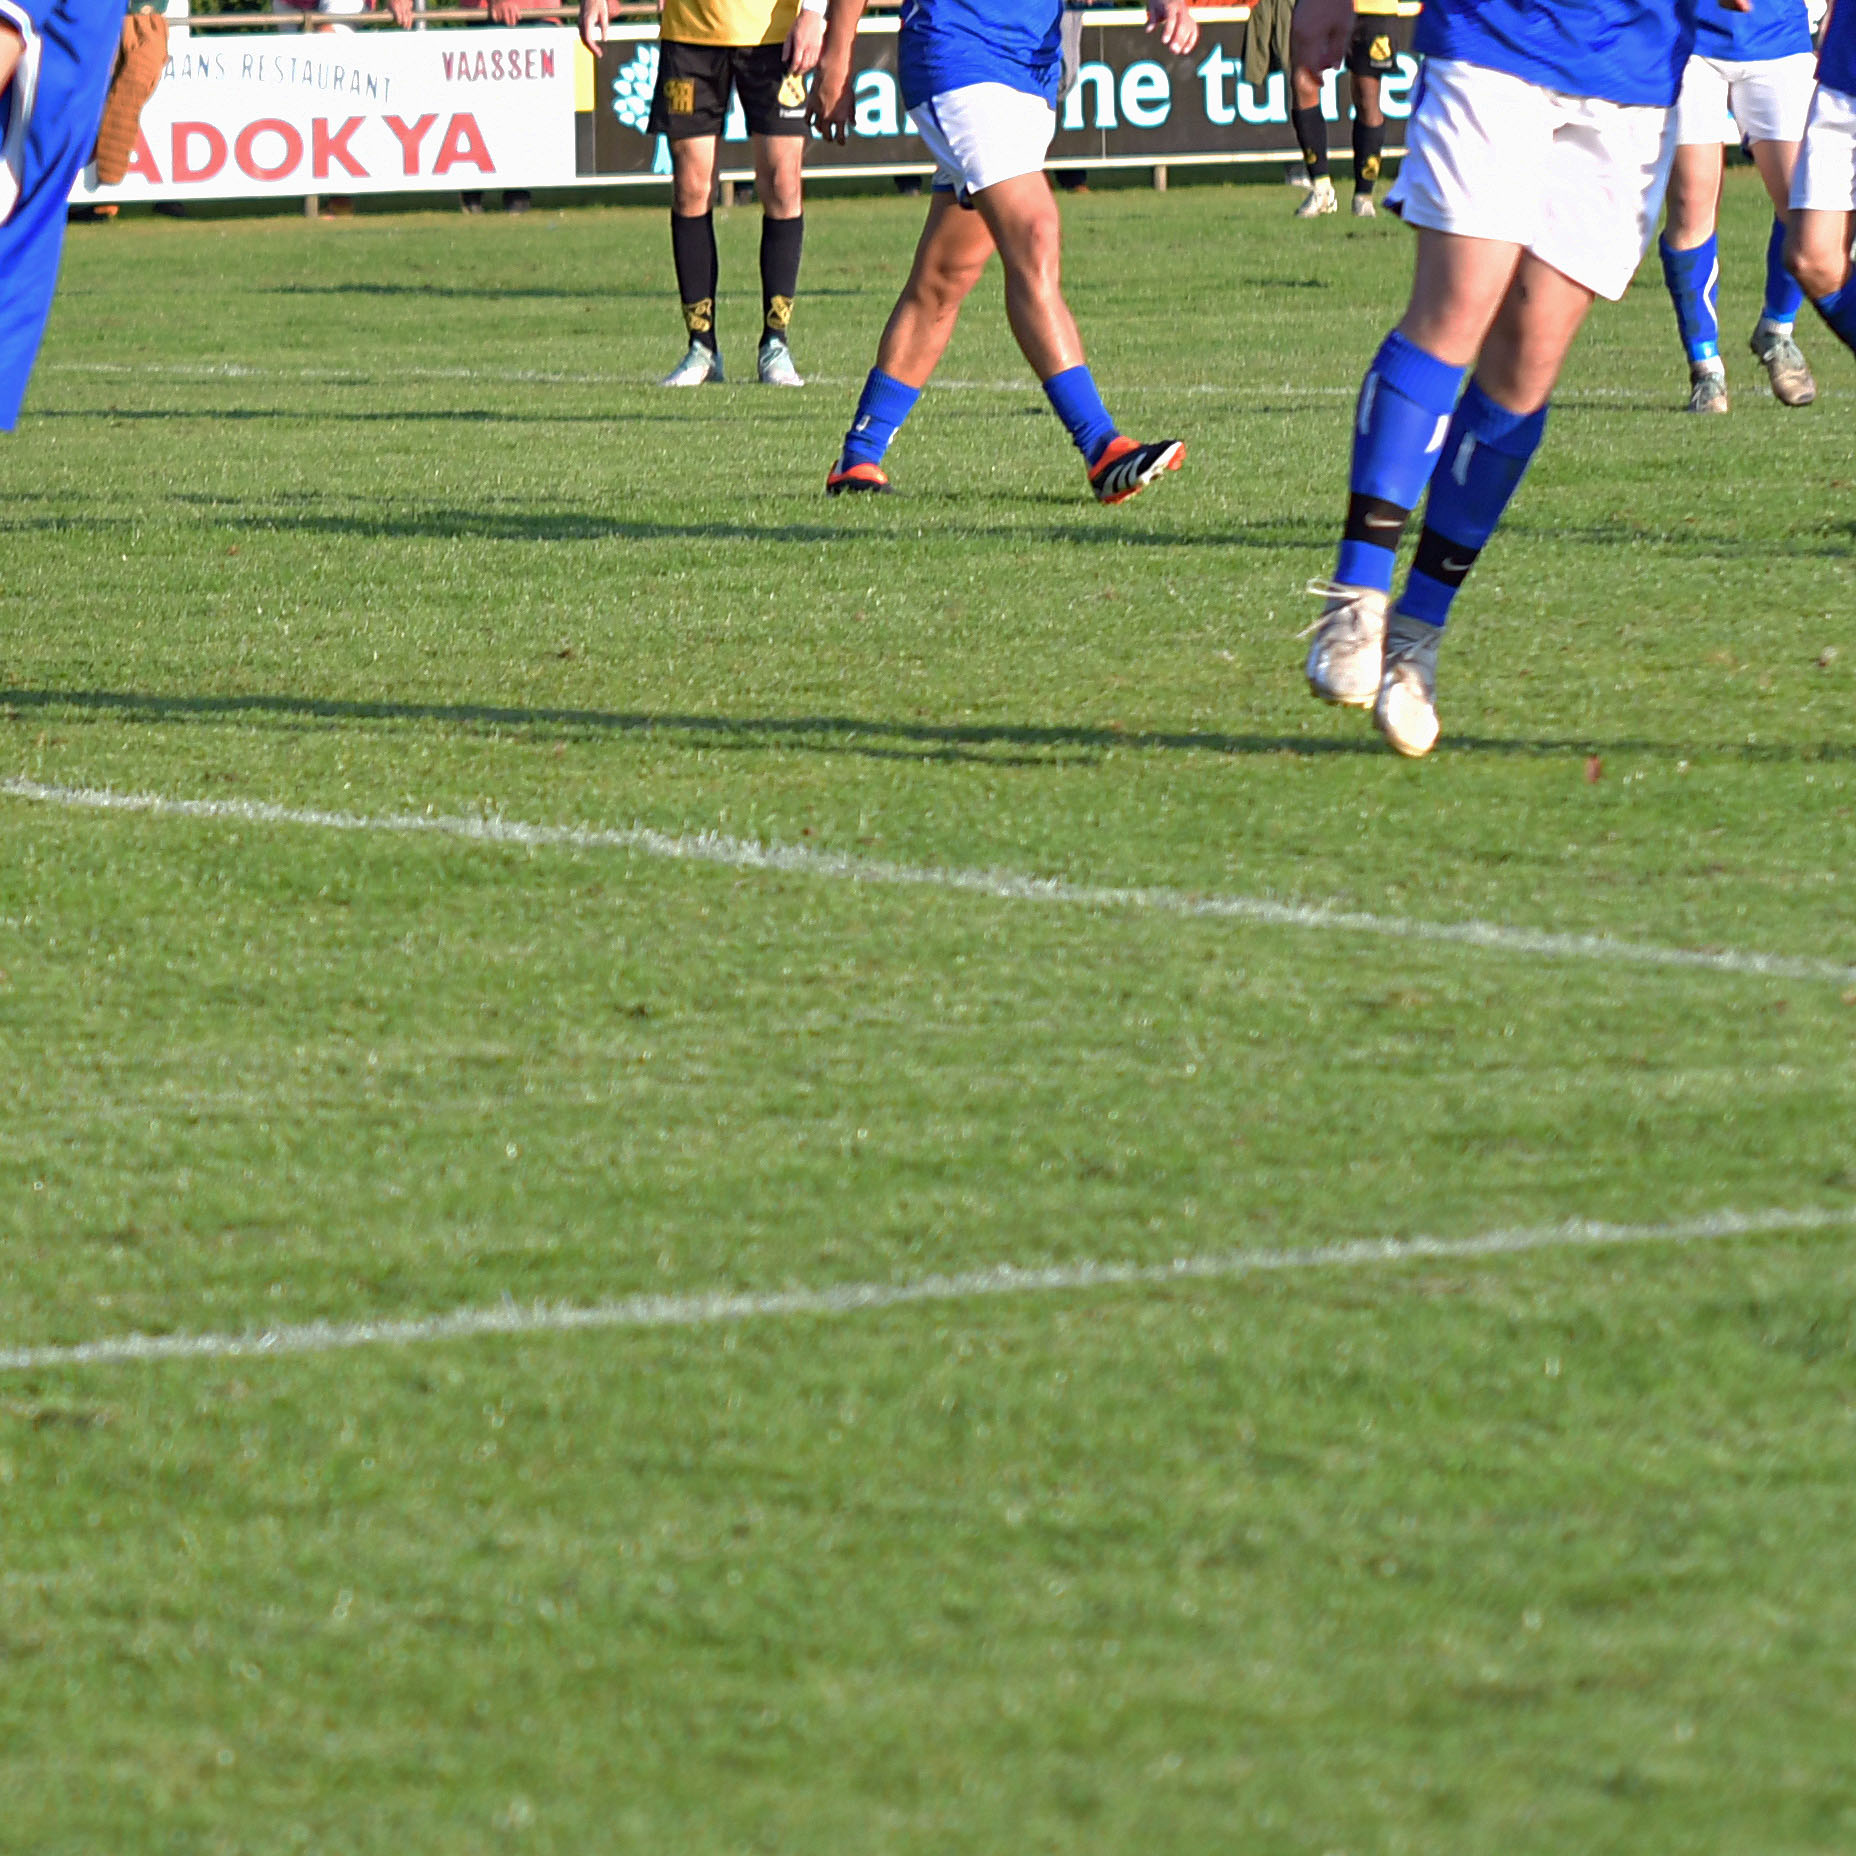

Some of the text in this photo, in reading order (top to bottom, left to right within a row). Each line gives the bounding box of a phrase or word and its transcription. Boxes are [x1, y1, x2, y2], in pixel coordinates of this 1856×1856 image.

[164, 52, 390, 103] AANS RESTAURANT
[443, 48, 555, 81] VAASSEN
